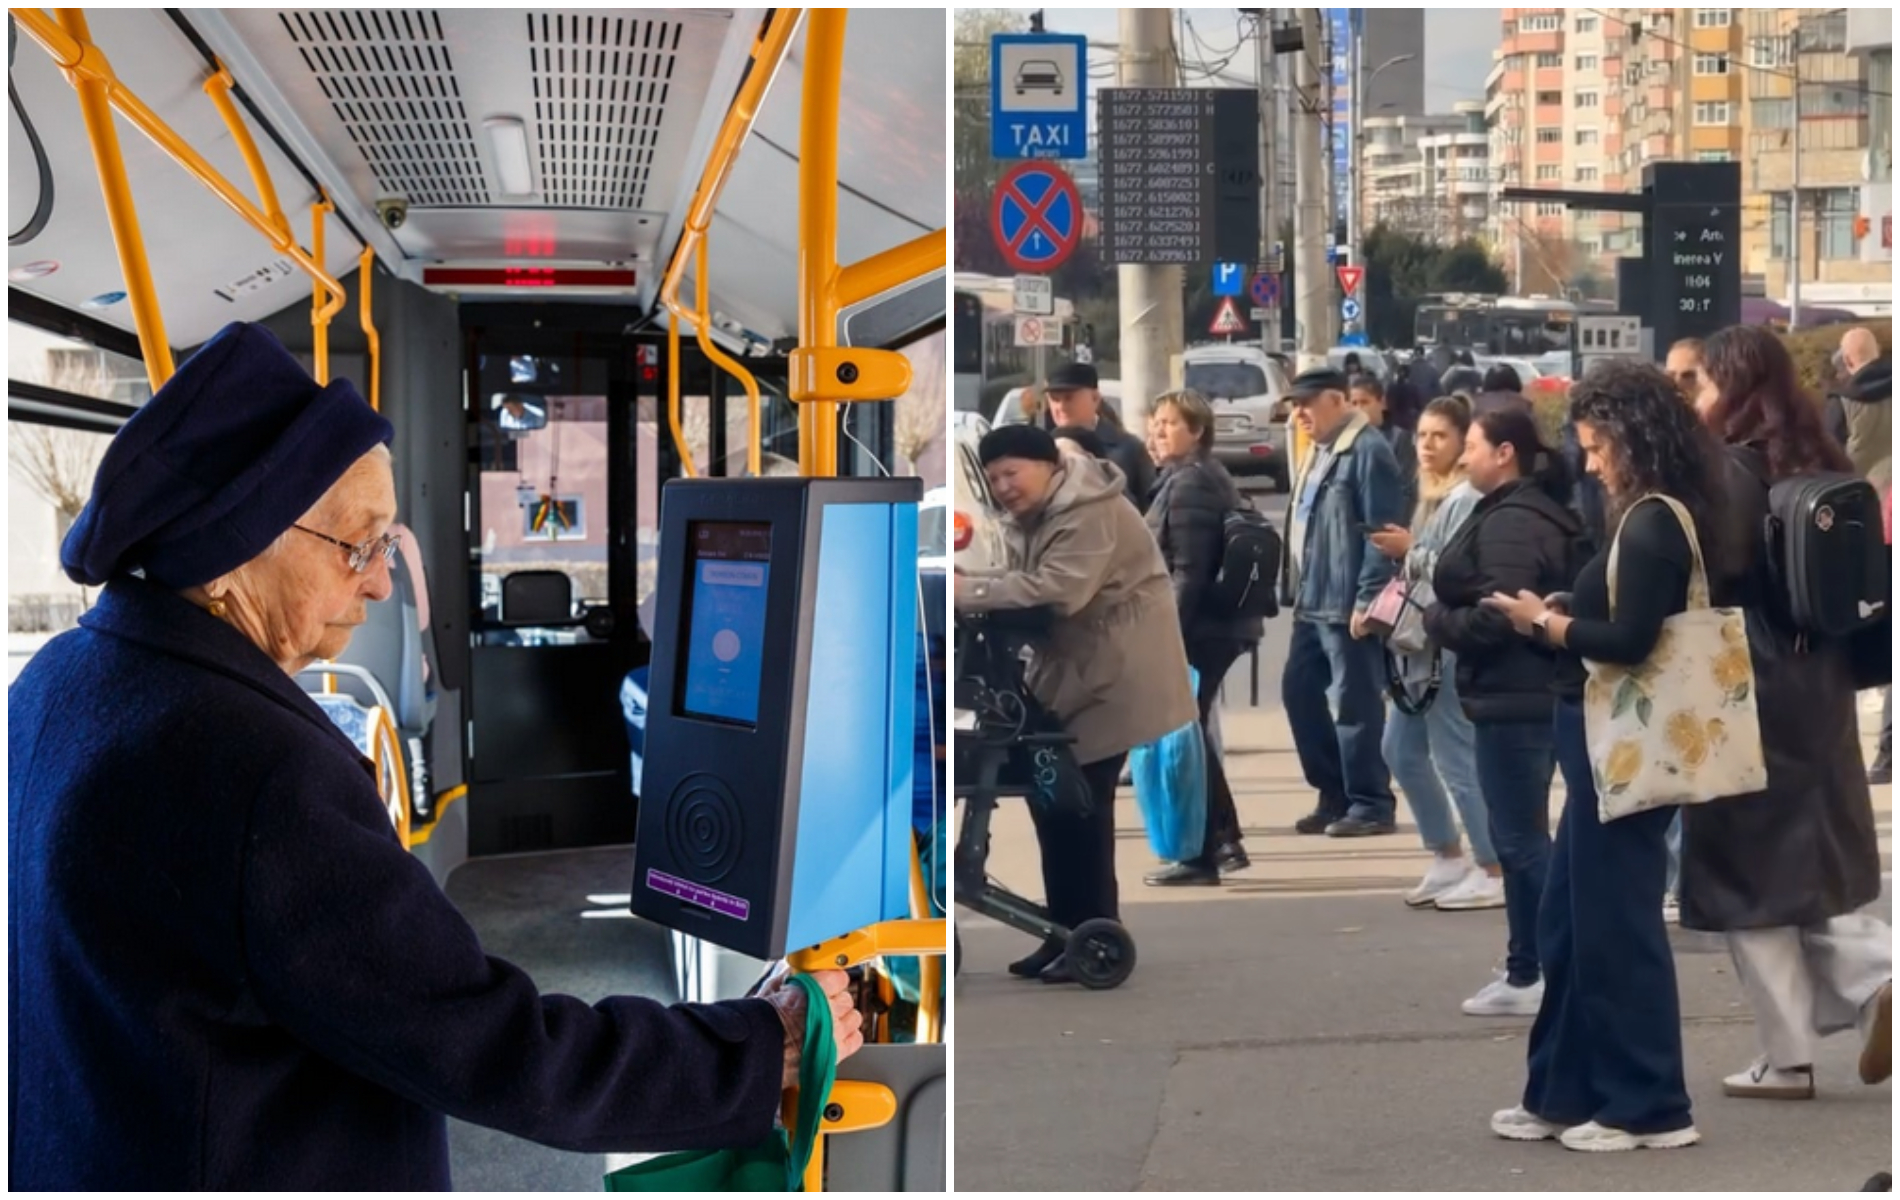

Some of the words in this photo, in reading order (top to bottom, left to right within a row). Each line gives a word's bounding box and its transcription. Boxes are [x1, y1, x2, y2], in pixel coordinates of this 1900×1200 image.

[1010, 124, 1069, 146] TAXI
[1020, 144, 1029, 158] 4
[1220, 262, 1237, 284] P
